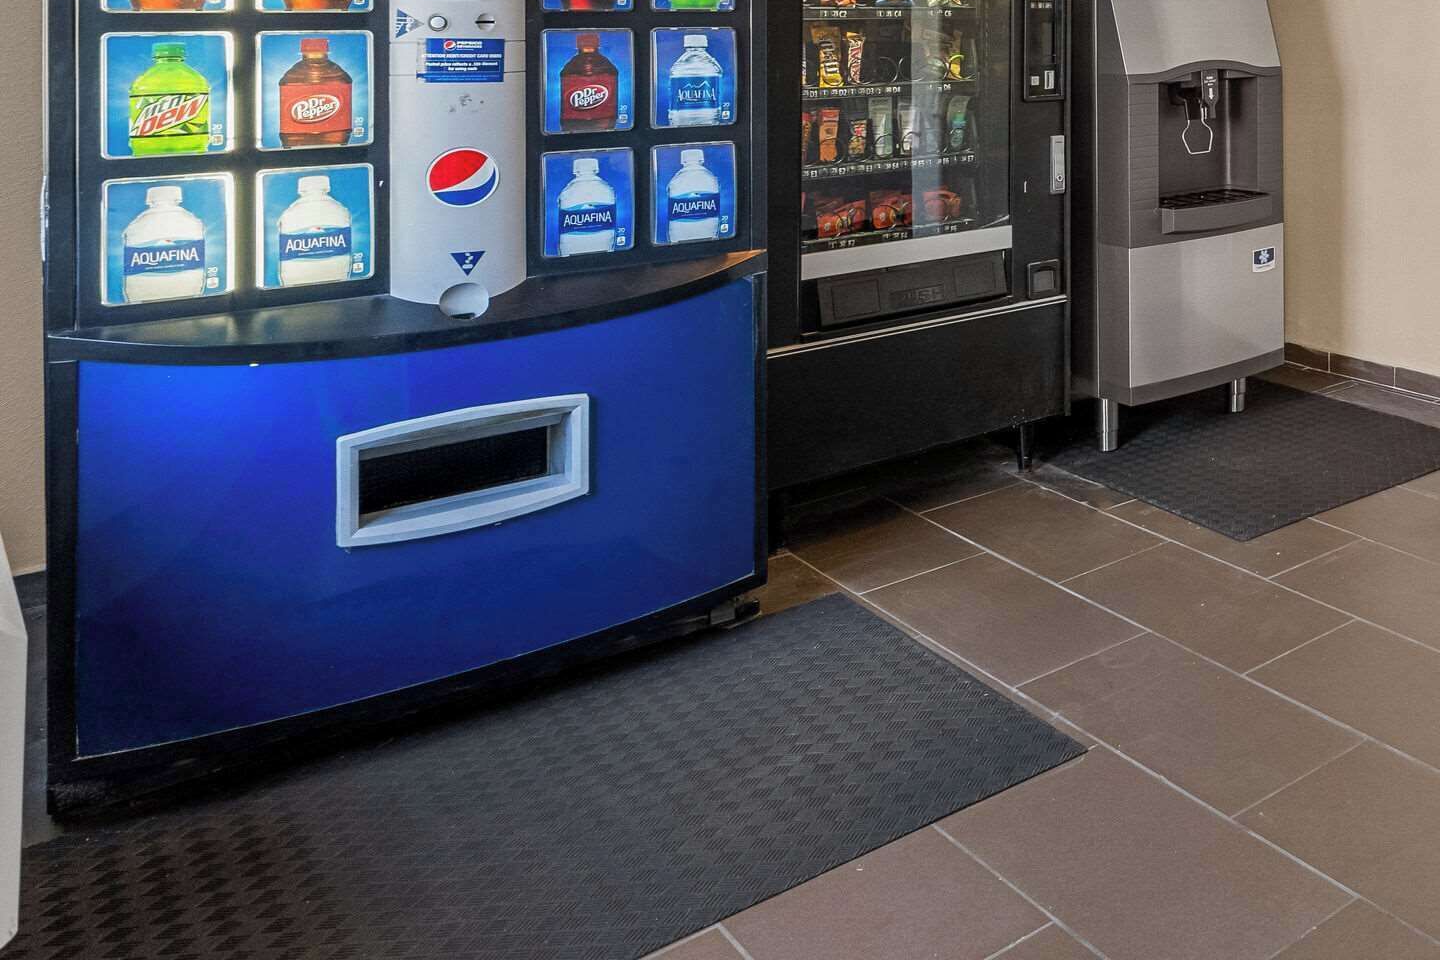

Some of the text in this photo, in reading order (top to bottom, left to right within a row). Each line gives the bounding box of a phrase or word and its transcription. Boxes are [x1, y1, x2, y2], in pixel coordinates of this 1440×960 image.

[574, 90, 605, 107] Pepper
[584, 88, 598, 97] Dr
[678, 88, 716, 101] AQUAFINA
[296, 100, 337, 120] Pepper
[309, 98, 326, 108] Dr
[672, 200, 716, 214] AQUAFINA
[564, 210, 612, 227] AQUAFINA
[286, 235, 346, 253] AQUAFINA
[130, 248, 200, 267] AQUAFINA
